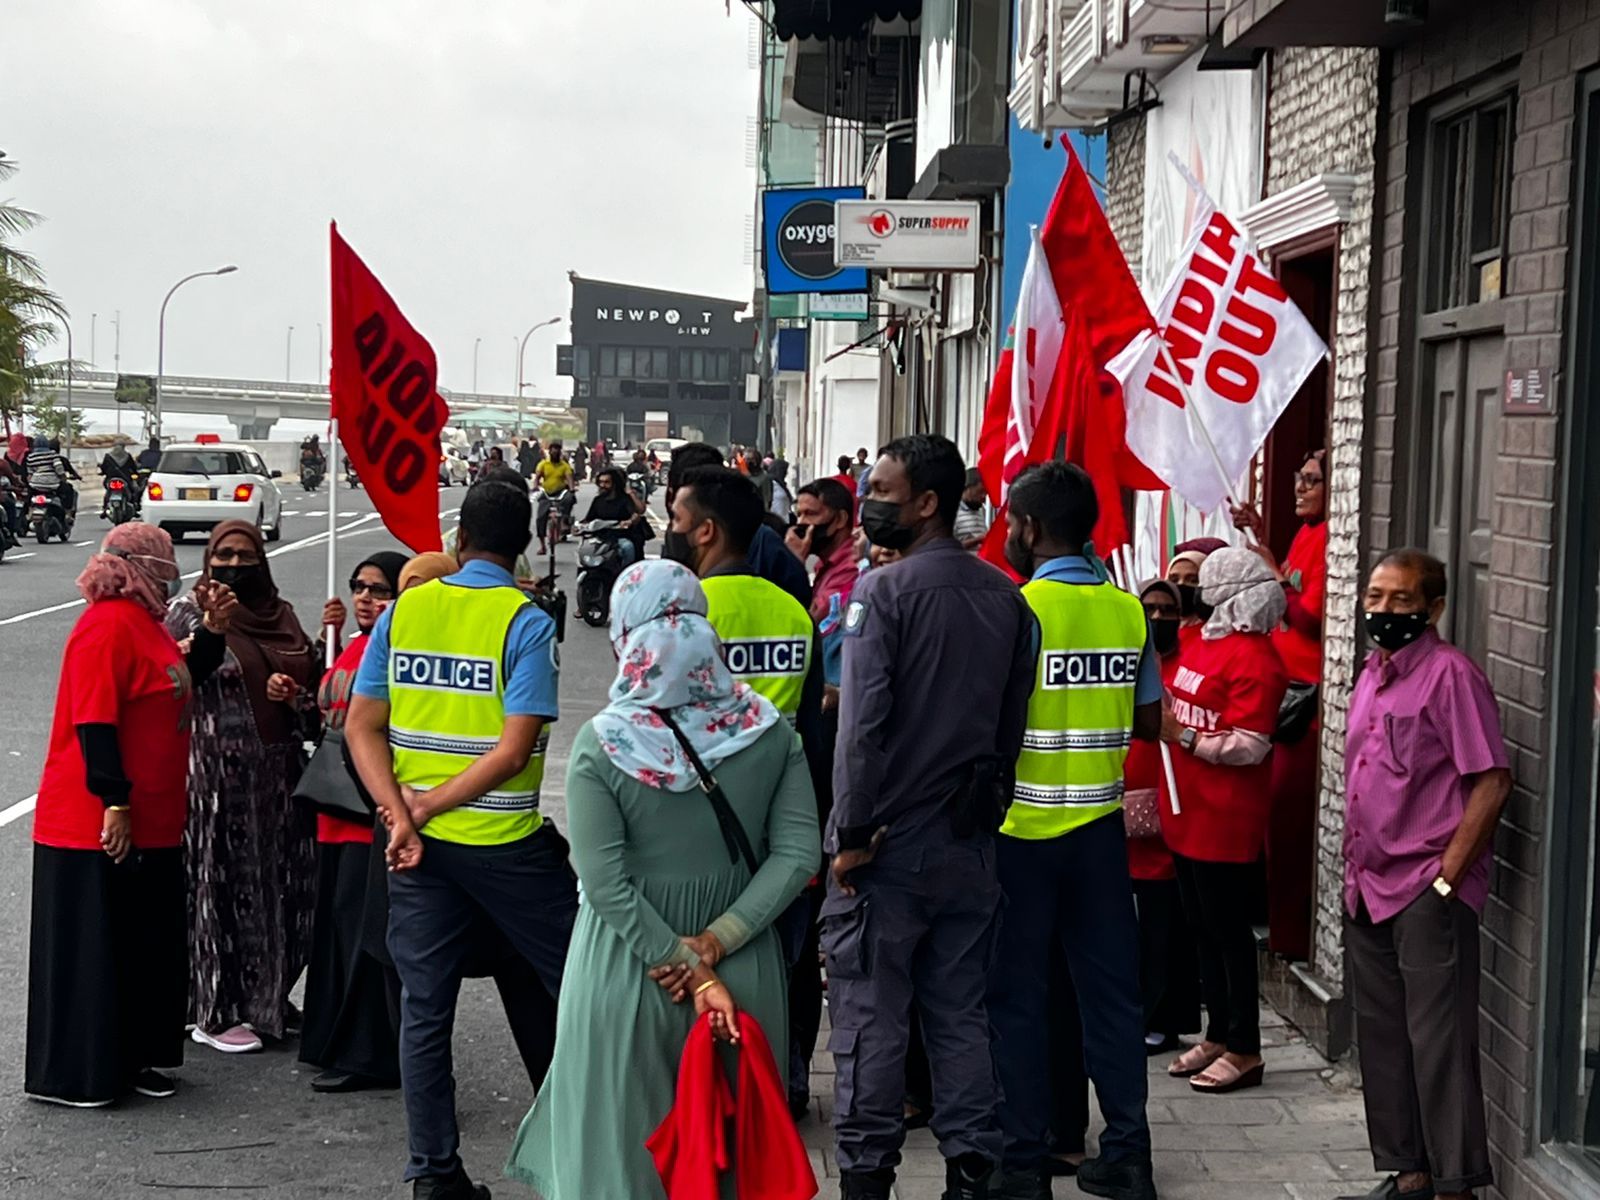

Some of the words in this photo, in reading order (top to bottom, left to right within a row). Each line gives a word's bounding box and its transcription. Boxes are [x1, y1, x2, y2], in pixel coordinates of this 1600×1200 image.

[785, 224, 836, 244] oxyge
[596, 308, 712, 325] NEWPOT
[1145, 211, 1241, 410] INDIA
[1204, 253, 1290, 405] OUT
[395, 655, 491, 689] POLICE
[720, 643, 805, 672] OLICE
[1049, 654, 1138, 684] POLICE
